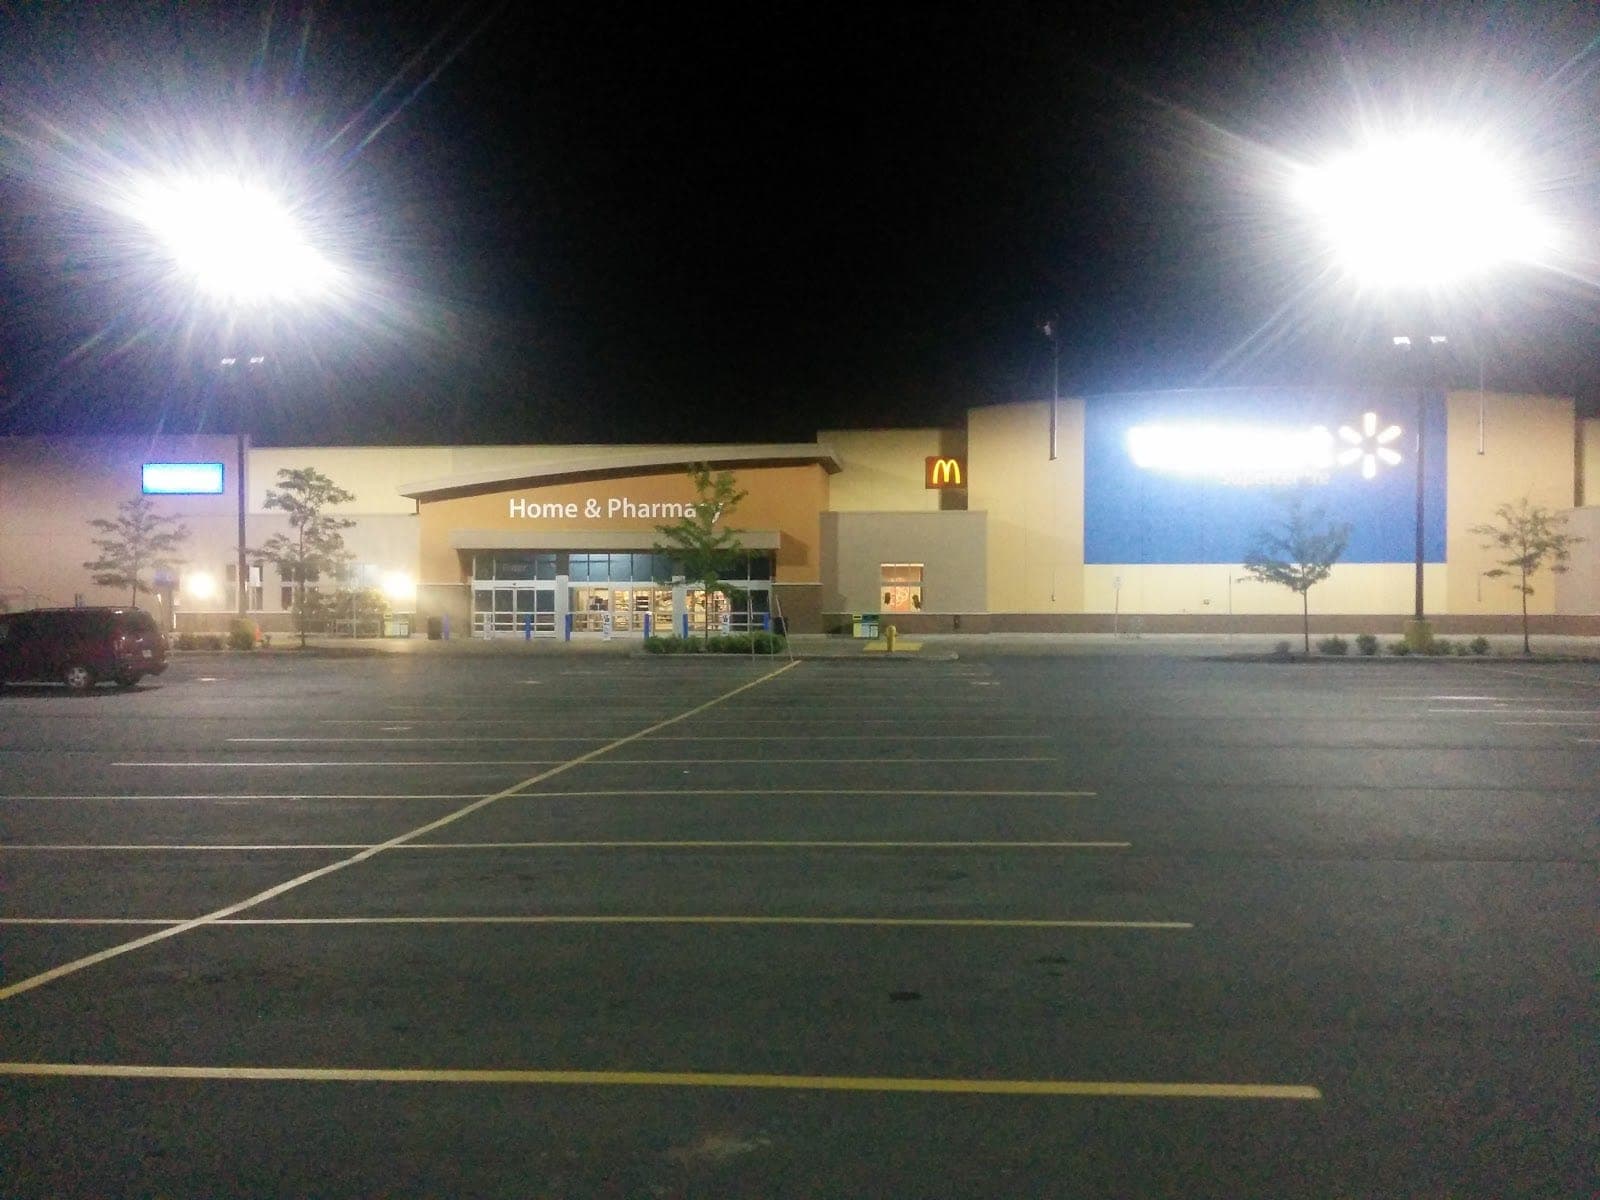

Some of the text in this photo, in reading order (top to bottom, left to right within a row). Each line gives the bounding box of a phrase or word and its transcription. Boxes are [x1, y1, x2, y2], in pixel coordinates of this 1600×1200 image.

[508, 497, 724, 524] Home & Pharmay
